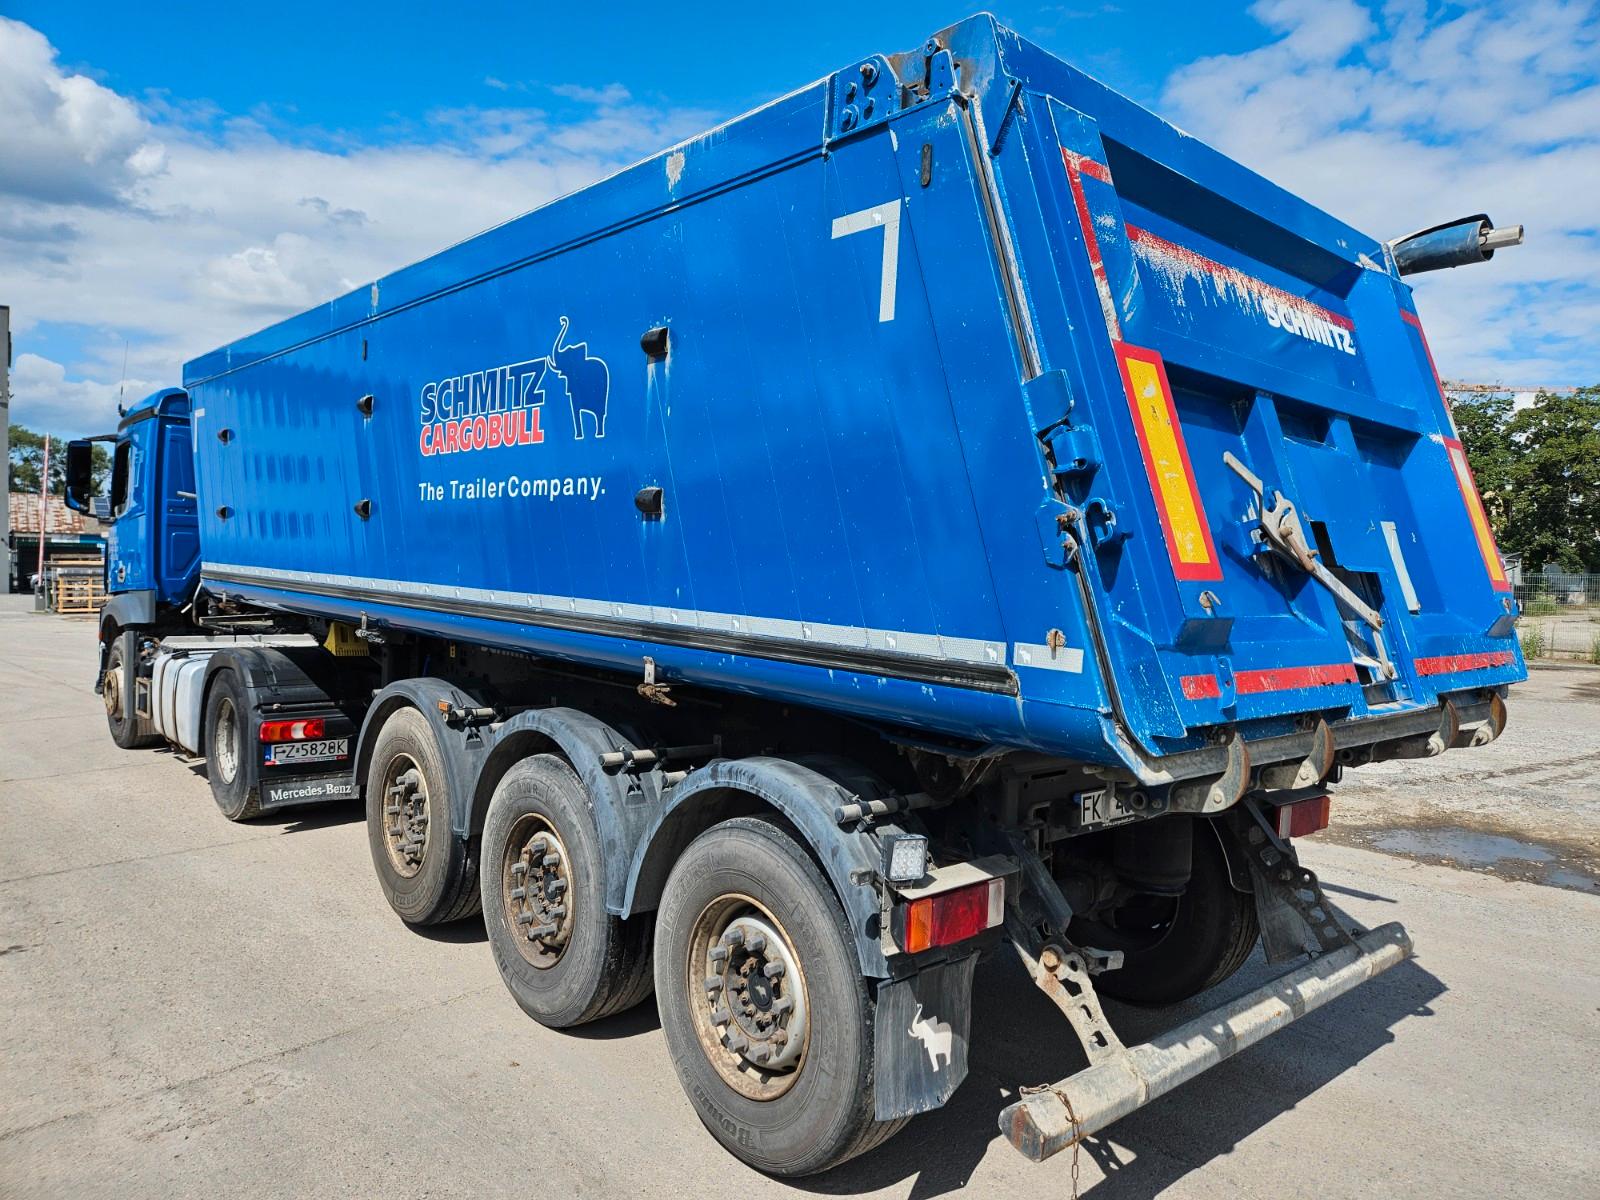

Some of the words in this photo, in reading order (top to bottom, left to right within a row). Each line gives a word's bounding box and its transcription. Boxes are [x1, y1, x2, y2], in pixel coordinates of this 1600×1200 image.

[1264, 298, 1356, 356] SCHMITZ
[420, 356, 547, 425] SCHMITZ
[419, 407, 545, 456] CARGOBULL
[419, 482, 445, 501] The
[269, 783, 352, 802] Mercedes-Benz
[1082, 794, 1102, 823] FK
